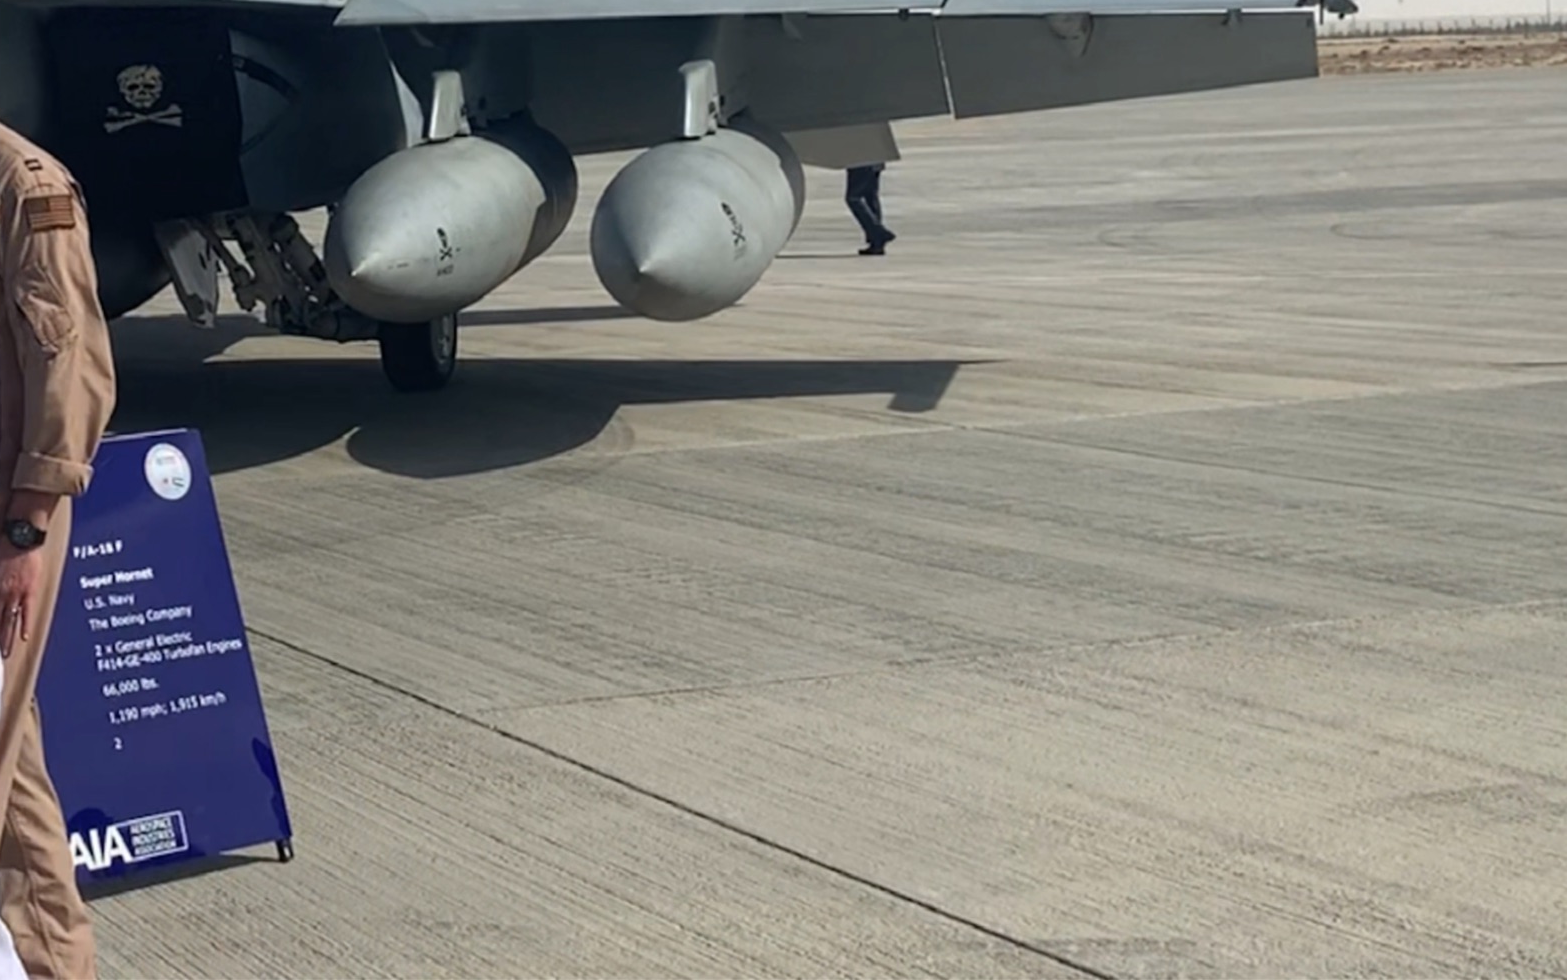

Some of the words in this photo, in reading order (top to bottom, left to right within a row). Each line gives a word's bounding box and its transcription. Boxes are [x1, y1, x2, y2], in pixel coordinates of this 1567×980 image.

[73, 541, 114, 559] F/A-18
[115, 539, 123, 553] F
[79, 573, 113, 589] Super
[114, 567, 154, 582] Hornet
[84, 596, 106, 610] U.S.
[108, 593, 135, 606] Navy
[88, 617, 109, 631] The
[111, 612, 145, 628] Boeing
[146, 605, 192, 622] Company
[94, 644, 102, 657] 2
[105, 645, 112, 654] x
[114, 635, 155, 653] General
[155, 631, 193, 647] Electric
[97, 651, 162, 671] F414-GE-400
[162, 643, 205, 660] Turbofan
[206, 638, 243, 654] Engines
[102, 679, 139, 697] 66,000
[140, 677, 159, 690] lbs.
[109, 706, 139, 724] 1,190
[169, 695, 199, 713] 1,915
[199, 691, 227, 706] km/h
[113, 736, 123, 750] 2
[69, 825, 134, 871] AIA
